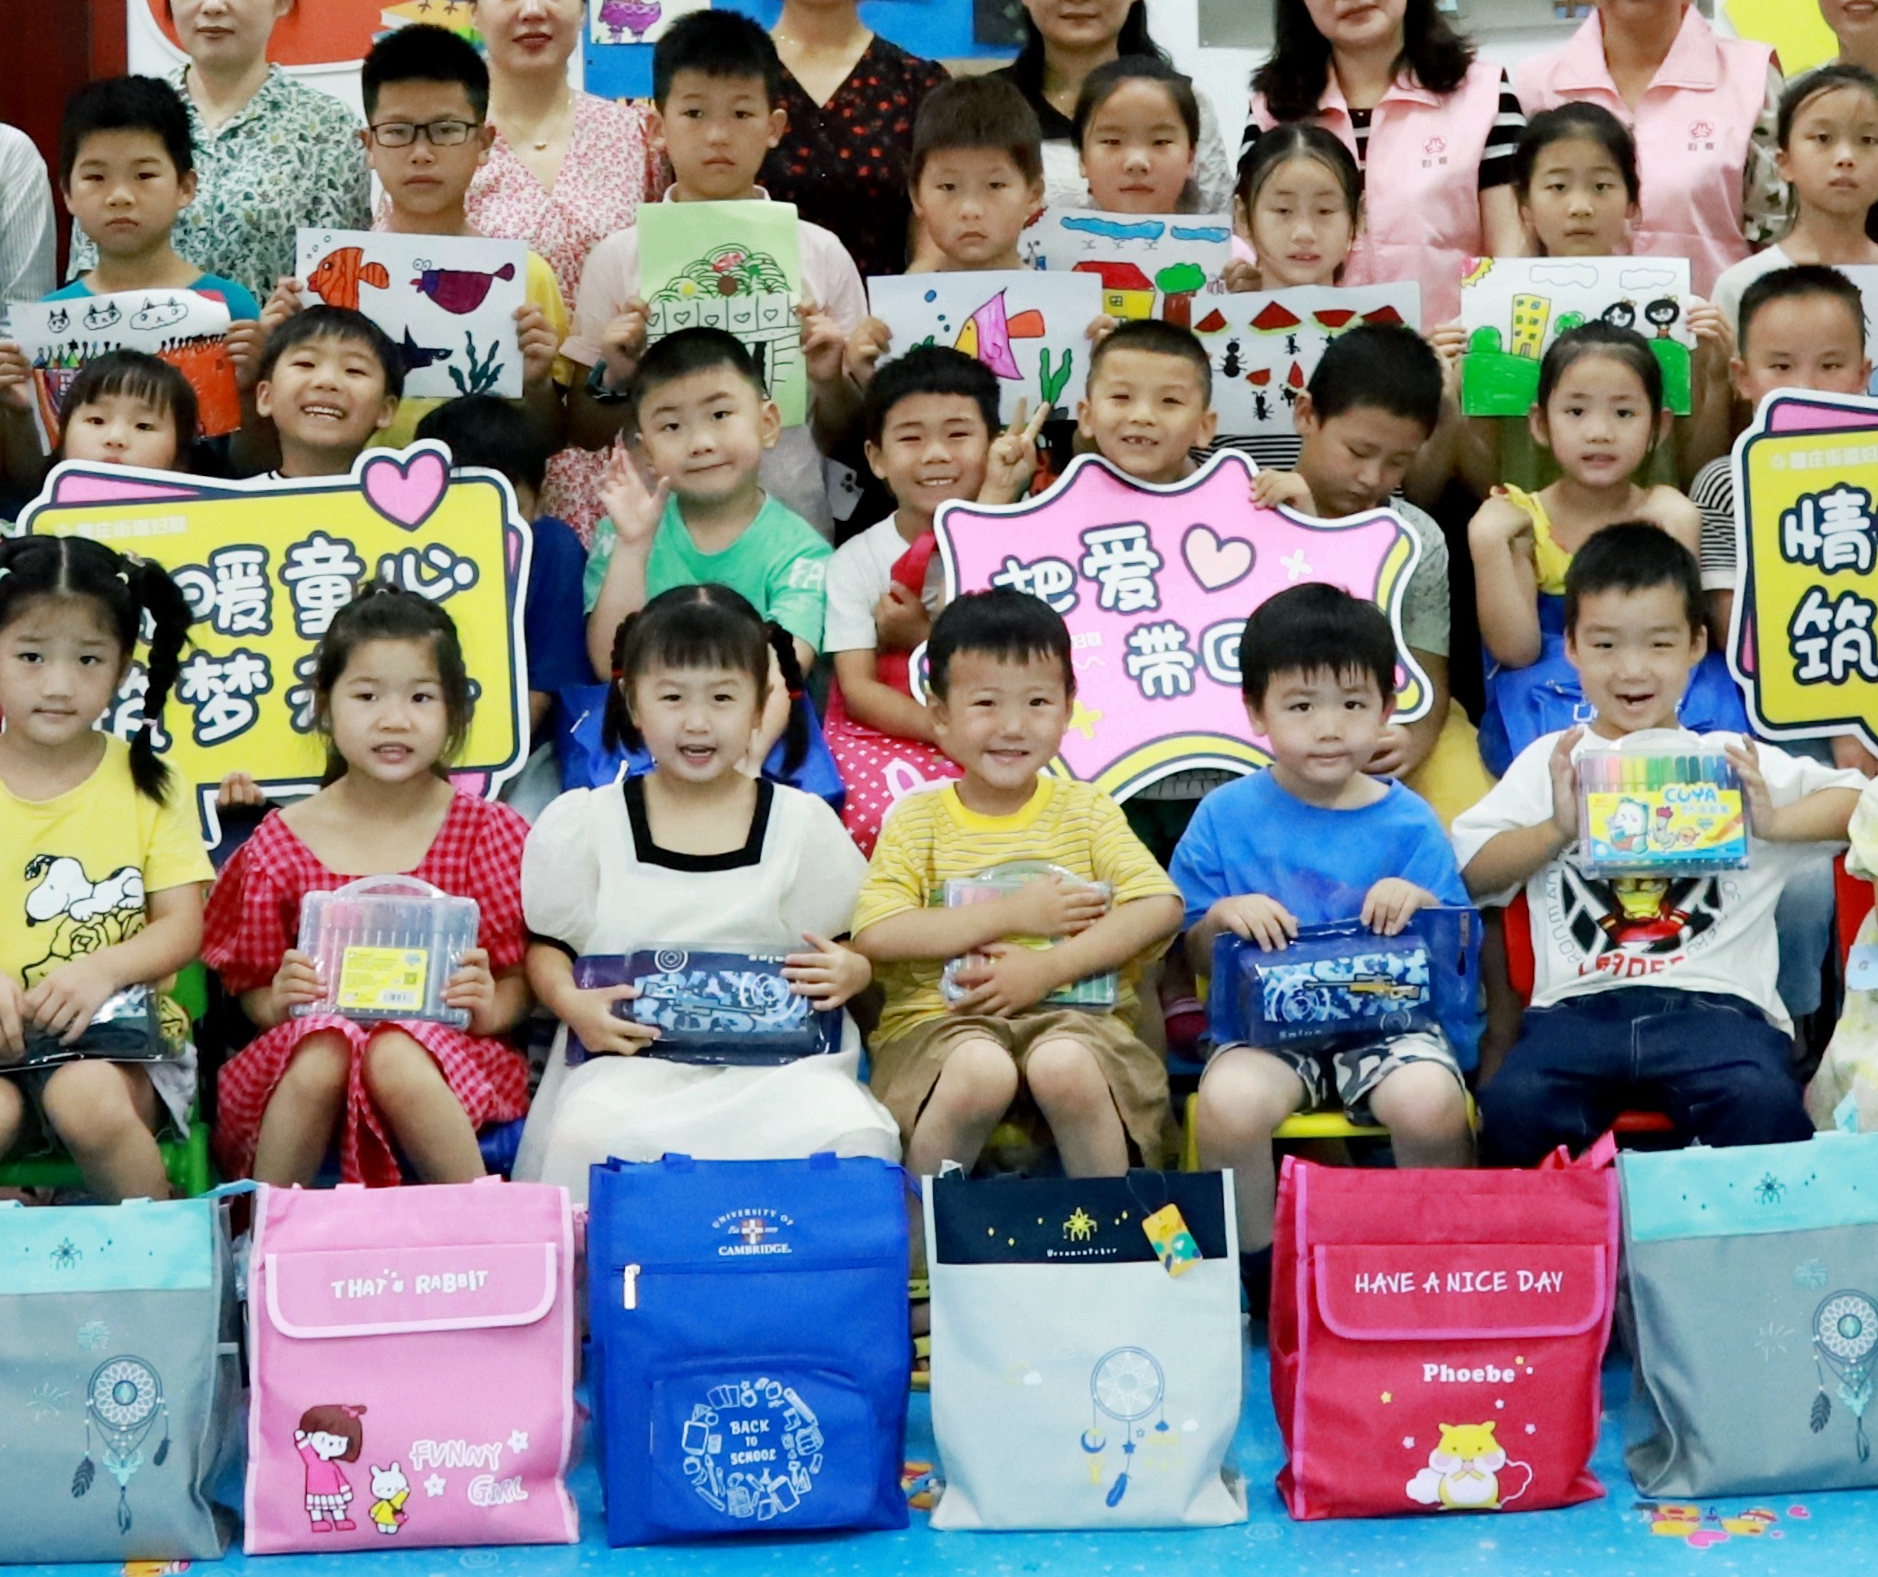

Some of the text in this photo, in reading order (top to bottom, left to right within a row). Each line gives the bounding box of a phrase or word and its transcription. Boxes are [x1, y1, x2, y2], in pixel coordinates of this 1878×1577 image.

[139, 534, 476, 640] 暖童心
[711, 1208, 778, 1229] UNIVERSITY
[1354, 1269, 1564, 1295] HAVE A NICE DAY
[1423, 1363, 1517, 1384] Phoebe
[729, 1419, 771, 1436] BACK
[745, 1435, 759, 1448] TO
[409, 1439, 503, 1472] FUNNY
[730, 1448, 778, 1466] SCHOOL
[467, 1474, 530, 1507] GIRL
